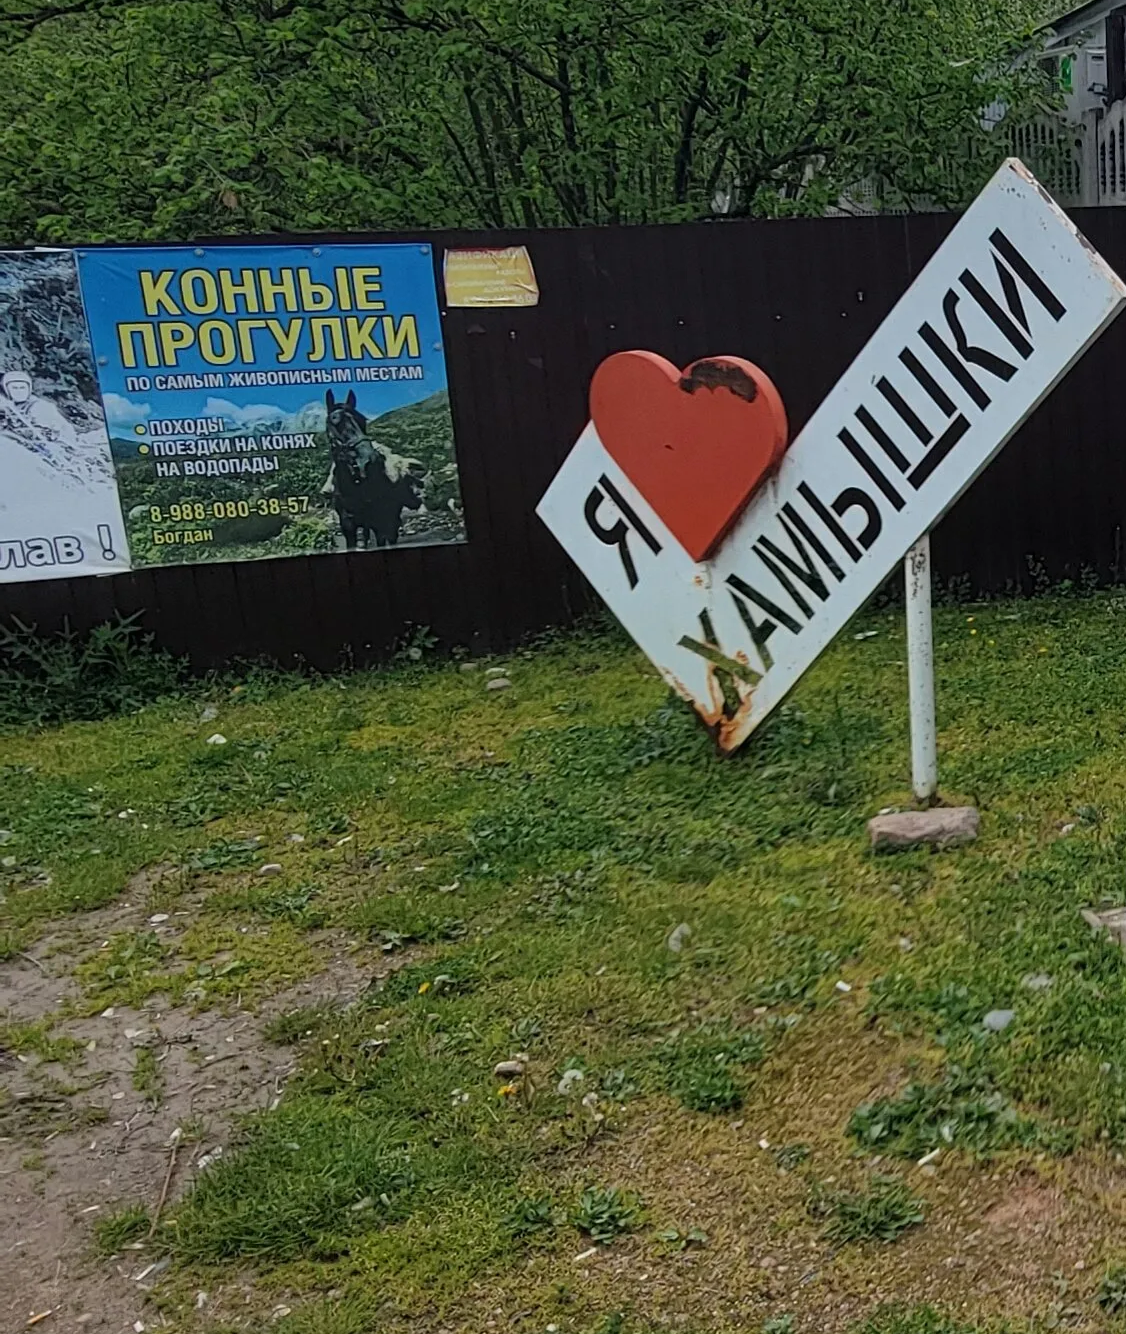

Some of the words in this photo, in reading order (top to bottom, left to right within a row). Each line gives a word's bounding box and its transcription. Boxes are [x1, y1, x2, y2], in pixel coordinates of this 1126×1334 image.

[140, 267, 385, 317] КОННЫЕ
[117, 315, 420, 368] ПРОГУЛКИ
[126, 376, 150, 392] ПО
[155, 372, 224, 390] САМЫМ
[228, 368, 351, 387] ЖИВОПИСНЫМ
[355, 365, 424, 382] МЕСТАМ
[150, 417, 224, 436] ПОХОДЫ
[153, 438, 231, 457] ПОЕЗДКИ
[235, 437, 258, 452] НА
[261, 433, 317, 451] КОНЯХ
[156, 462, 181, 478] НА
[184, 455, 280, 476] ВОДОПАДЫ
[676, 227, 1067, 720] ХАМЫШКИ
[150, 495, 309, 524] 8-988-080-38-57
[153, 528, 214, 545] Богдан
[583, 472, 663, 590] Я
